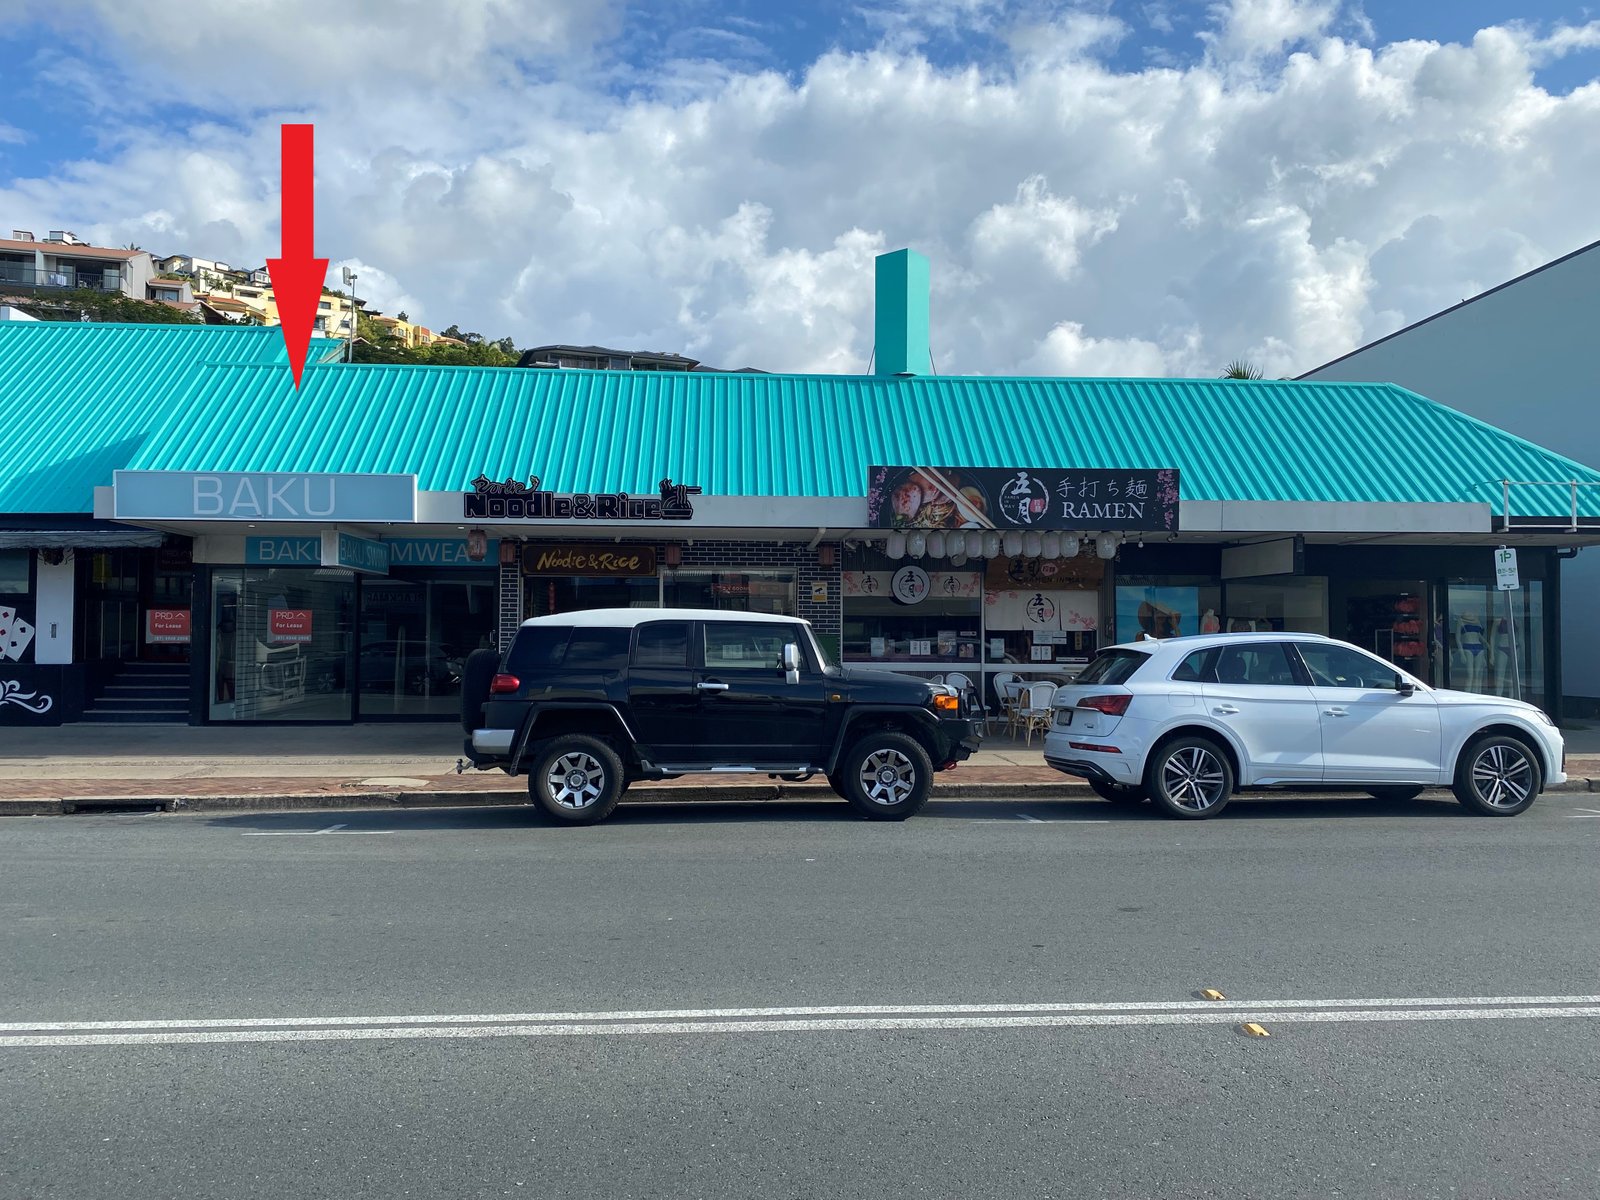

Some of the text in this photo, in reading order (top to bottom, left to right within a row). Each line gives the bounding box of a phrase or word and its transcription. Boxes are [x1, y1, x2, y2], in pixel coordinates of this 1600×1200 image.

[193, 476, 336, 516] BAKU
[1062, 501, 1145, 519] RAMEN
[340, 538, 365, 564] BAKU
